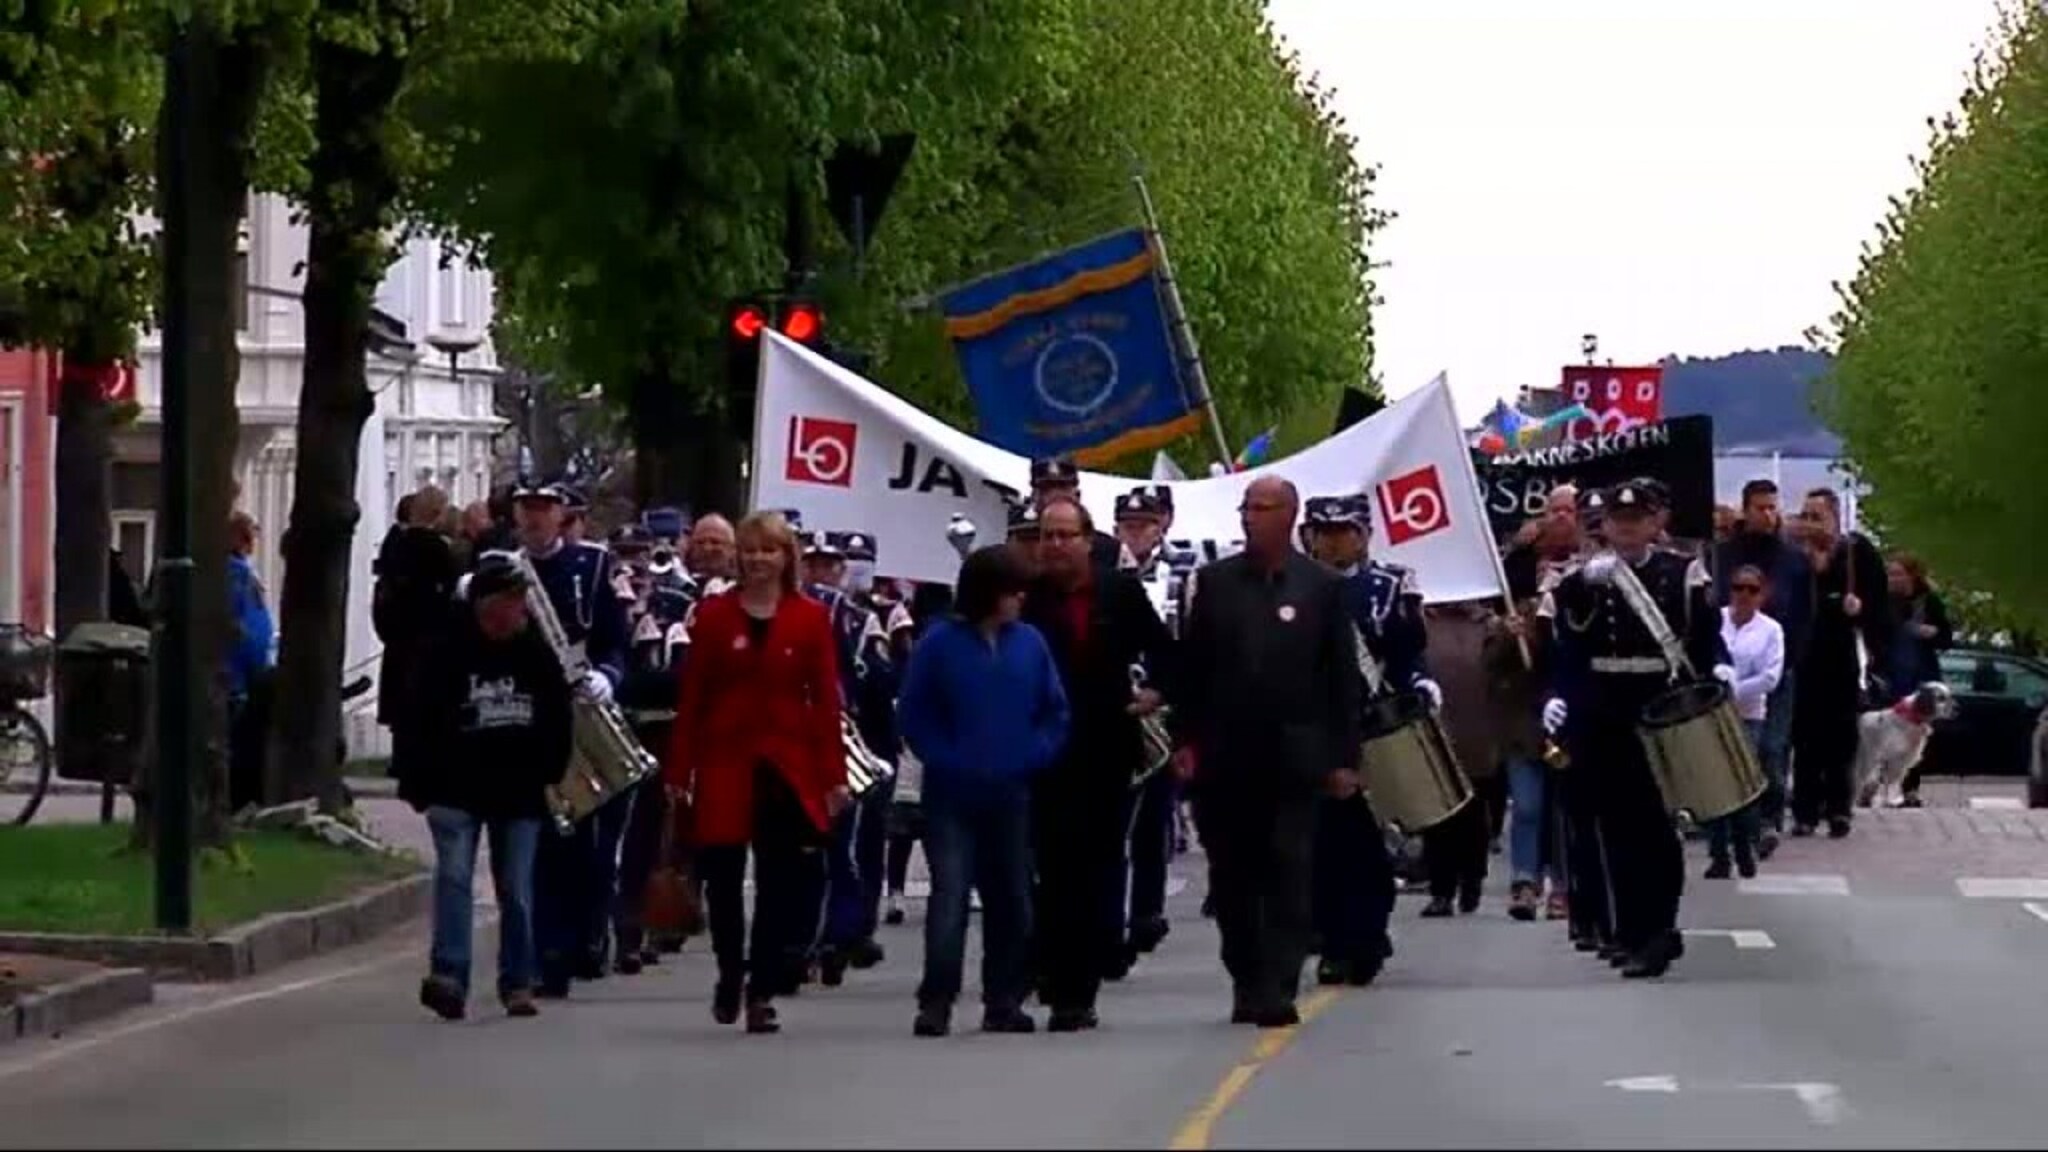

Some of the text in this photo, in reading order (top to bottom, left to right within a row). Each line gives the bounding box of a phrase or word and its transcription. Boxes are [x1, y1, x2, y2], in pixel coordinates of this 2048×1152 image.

[790, 415, 849, 480] LO
[888, 442, 968, 498] JA
[1379, 481, 1442, 531] LO
